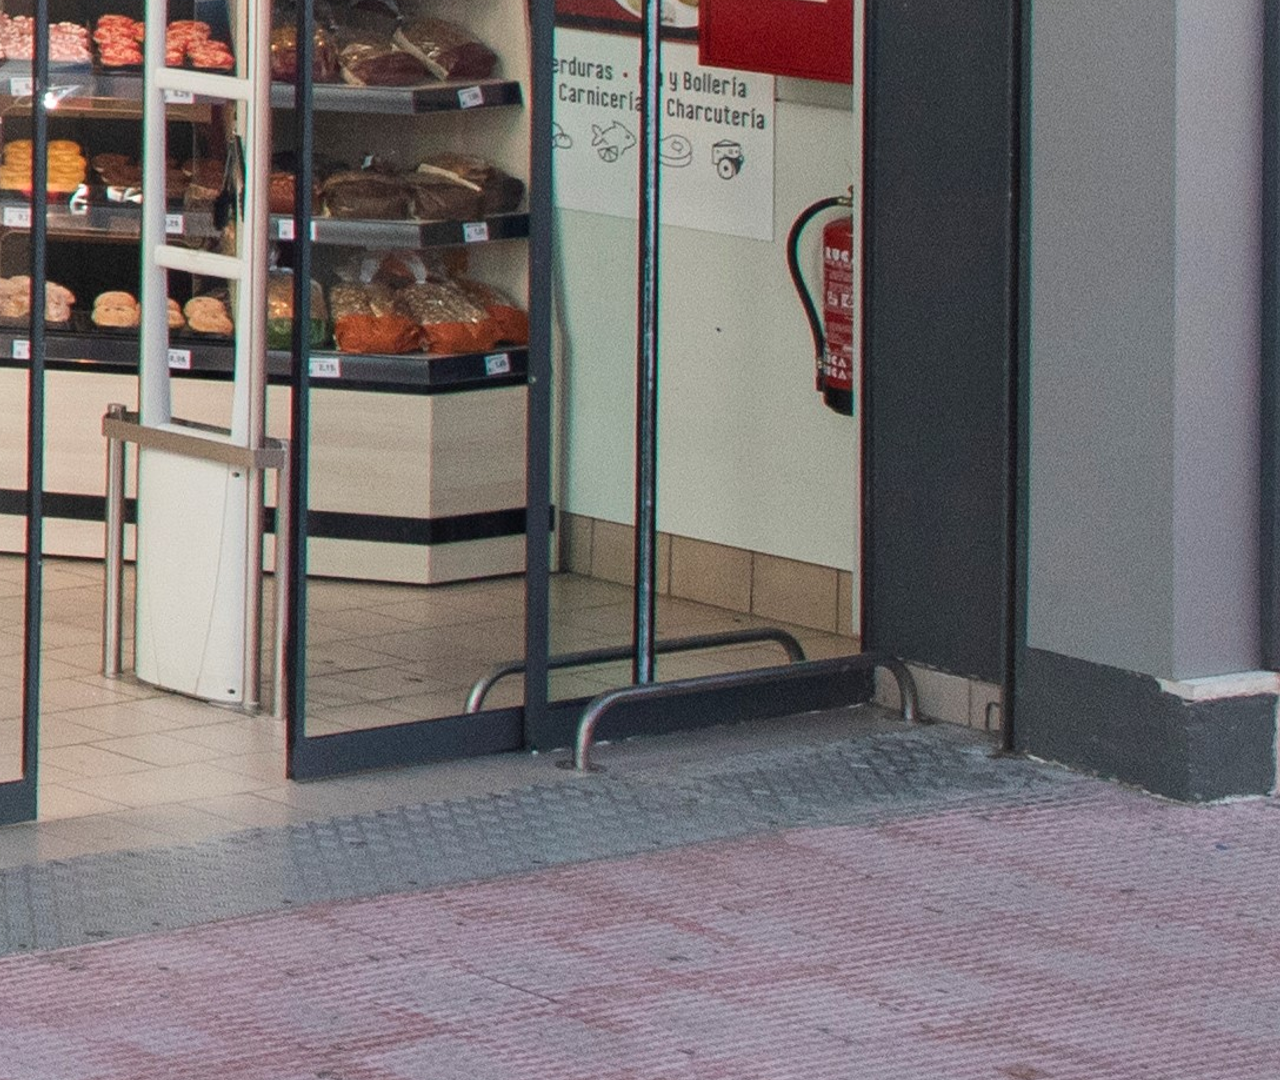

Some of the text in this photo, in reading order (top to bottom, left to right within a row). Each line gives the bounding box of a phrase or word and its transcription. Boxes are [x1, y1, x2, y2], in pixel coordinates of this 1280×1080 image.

[552, 56, 613, 80] erduras
[683, 71, 747, 98] Bollería
[559, 83, 765, 129] Carnicería Charcutería
